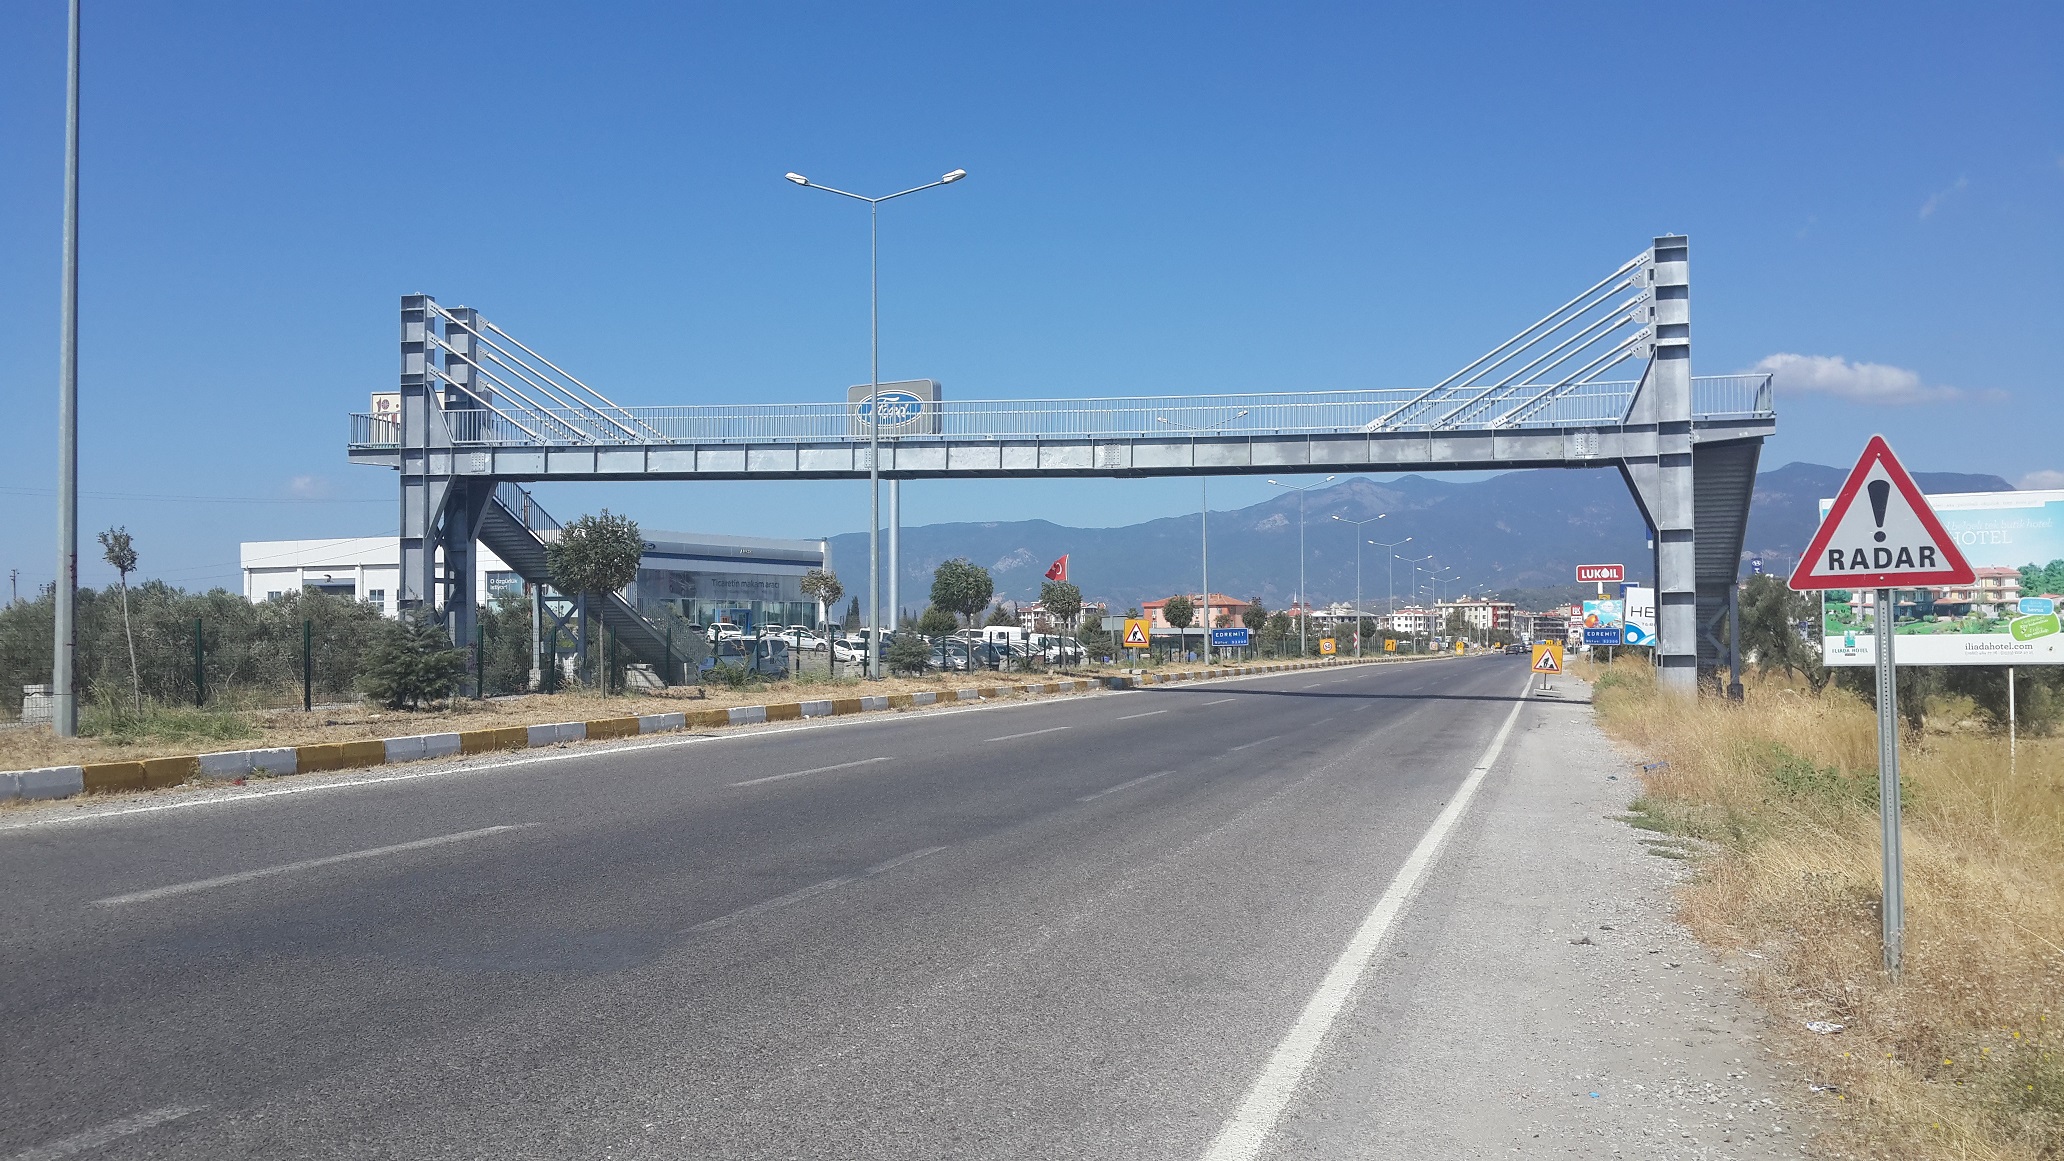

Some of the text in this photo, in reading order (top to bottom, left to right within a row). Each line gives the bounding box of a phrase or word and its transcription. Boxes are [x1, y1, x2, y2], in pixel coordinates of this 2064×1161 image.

[1828, 545, 1936, 571] RADAR
[1581, 567, 1619, 579] LUKOIL
[711, 578, 739, 588] Ticaretin
[741, 580, 764, 589] makam
[1964, 641, 2034, 651] iliadahotel.com
